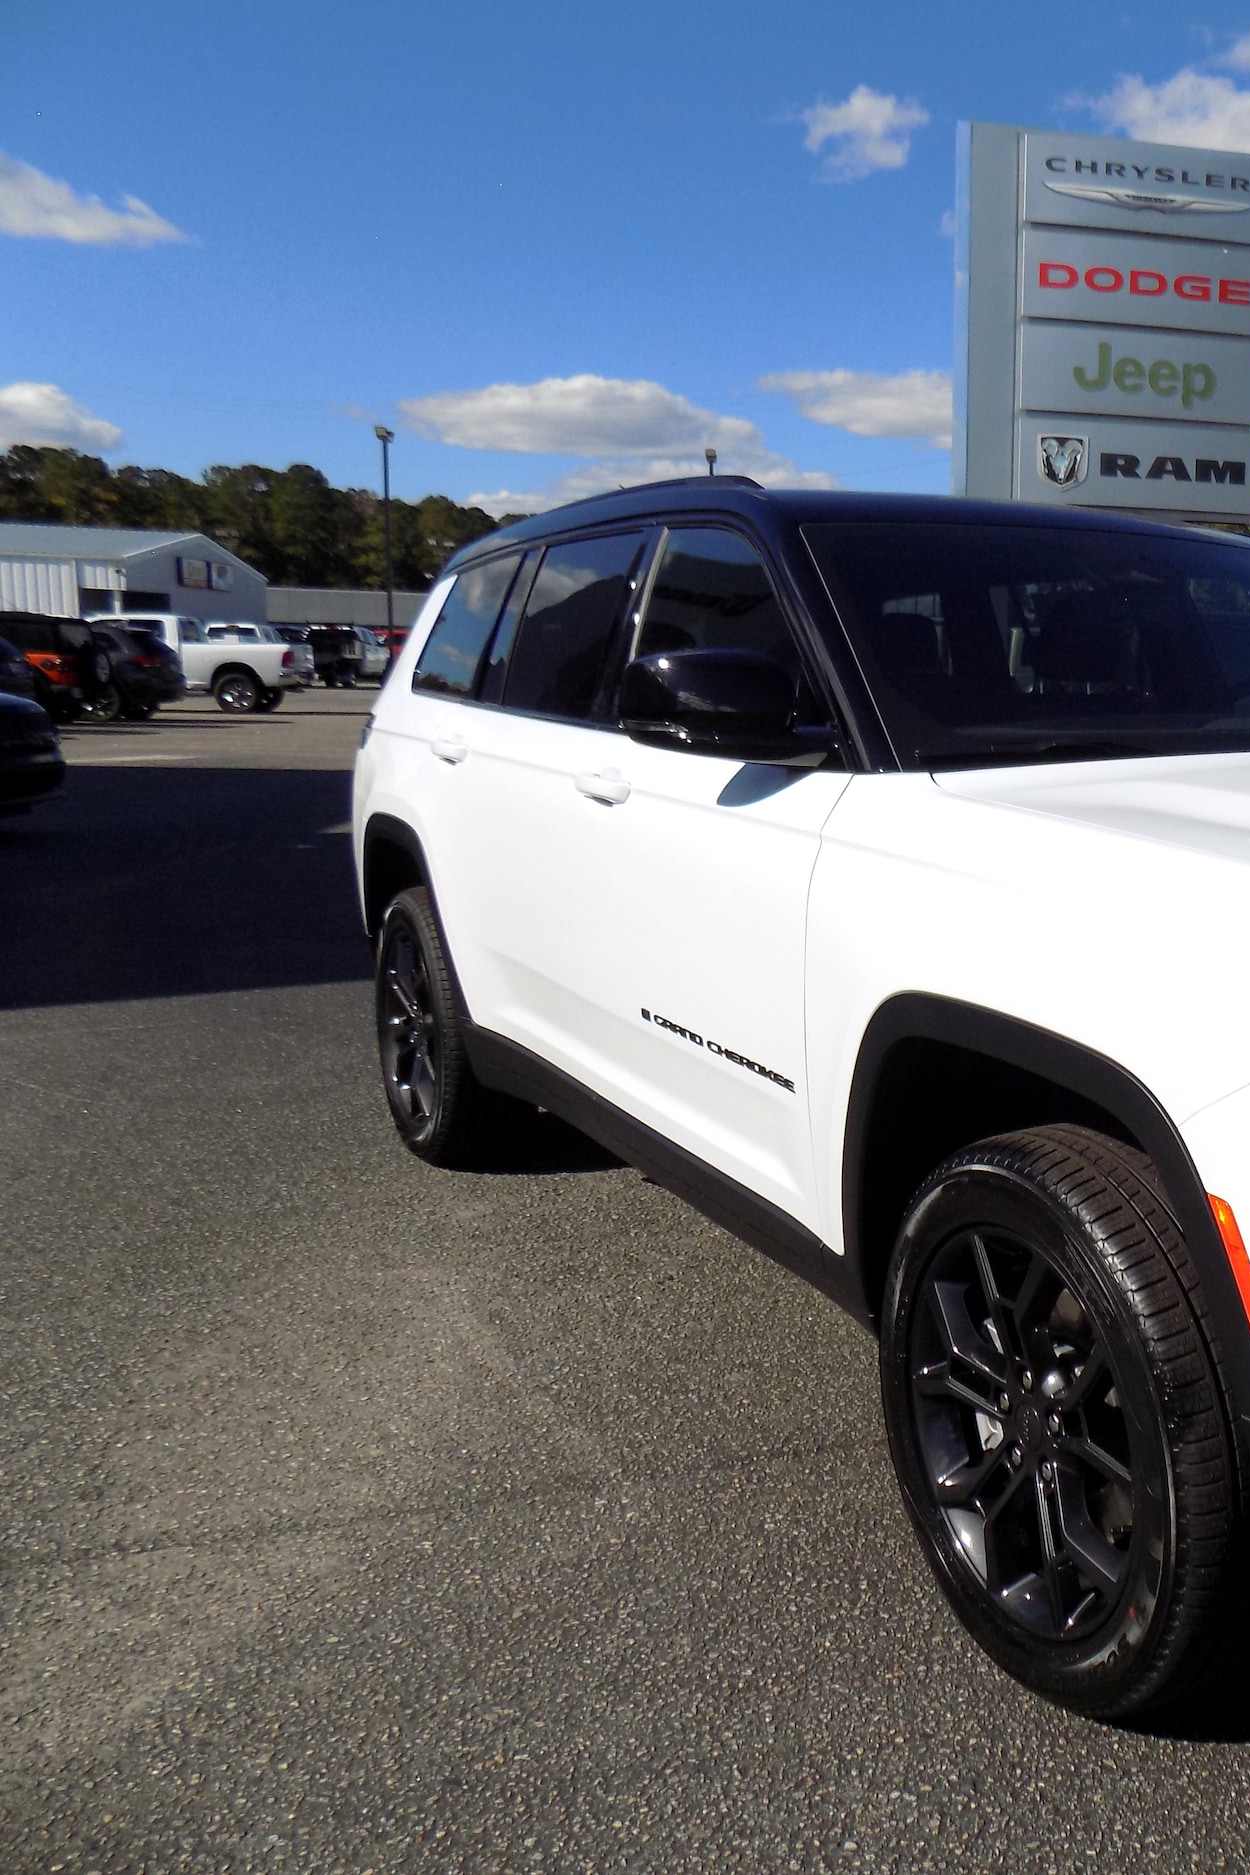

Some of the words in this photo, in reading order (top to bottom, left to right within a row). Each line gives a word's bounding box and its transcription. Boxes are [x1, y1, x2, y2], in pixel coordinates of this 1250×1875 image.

[1045, 157, 1250, 193] CHRYSLER
[1072, 341, 1217, 409] Jeep
[1099, 452, 1246, 485] RAM
[653, 1014, 704, 1047] GRAND
[706, 1040, 796, 1094] CHEROKEE
